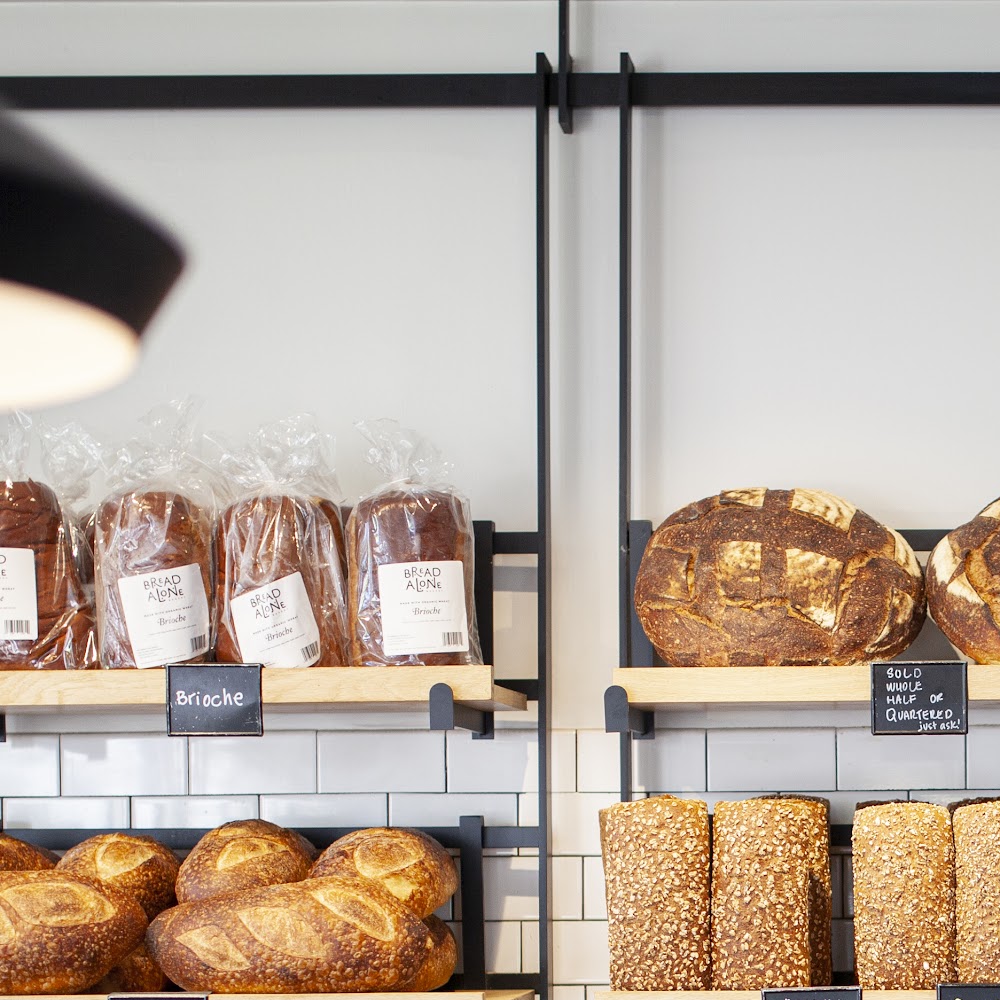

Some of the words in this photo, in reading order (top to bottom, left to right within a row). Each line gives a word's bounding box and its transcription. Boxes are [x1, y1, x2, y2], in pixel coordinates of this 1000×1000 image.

[404, 566, 441, 578] BREAD
[144, 574, 182, 591] BREAD
[406, 577, 442, 592] ALONE
[148, 585, 184, 603] ALONE
[250, 588, 281, 608] BREAD
[255, 599, 287, 619] ALONE
[412, 606, 441, 616] Brioche
[157, 614, 187, 626] Brioche
[265, 627, 293, 641] Brioche
[886, 667, 922, 679] SOLD
[886, 681, 923, 692] WHOLE
[176, 688, 244, 707] Brioche
[886, 694, 917, 704] HALF
[929, 692, 944, 704] OR
[886, 708, 953, 722] QUARTERED
[917, 720, 937, 732] just
[940, 718, 961, 731] ask!
